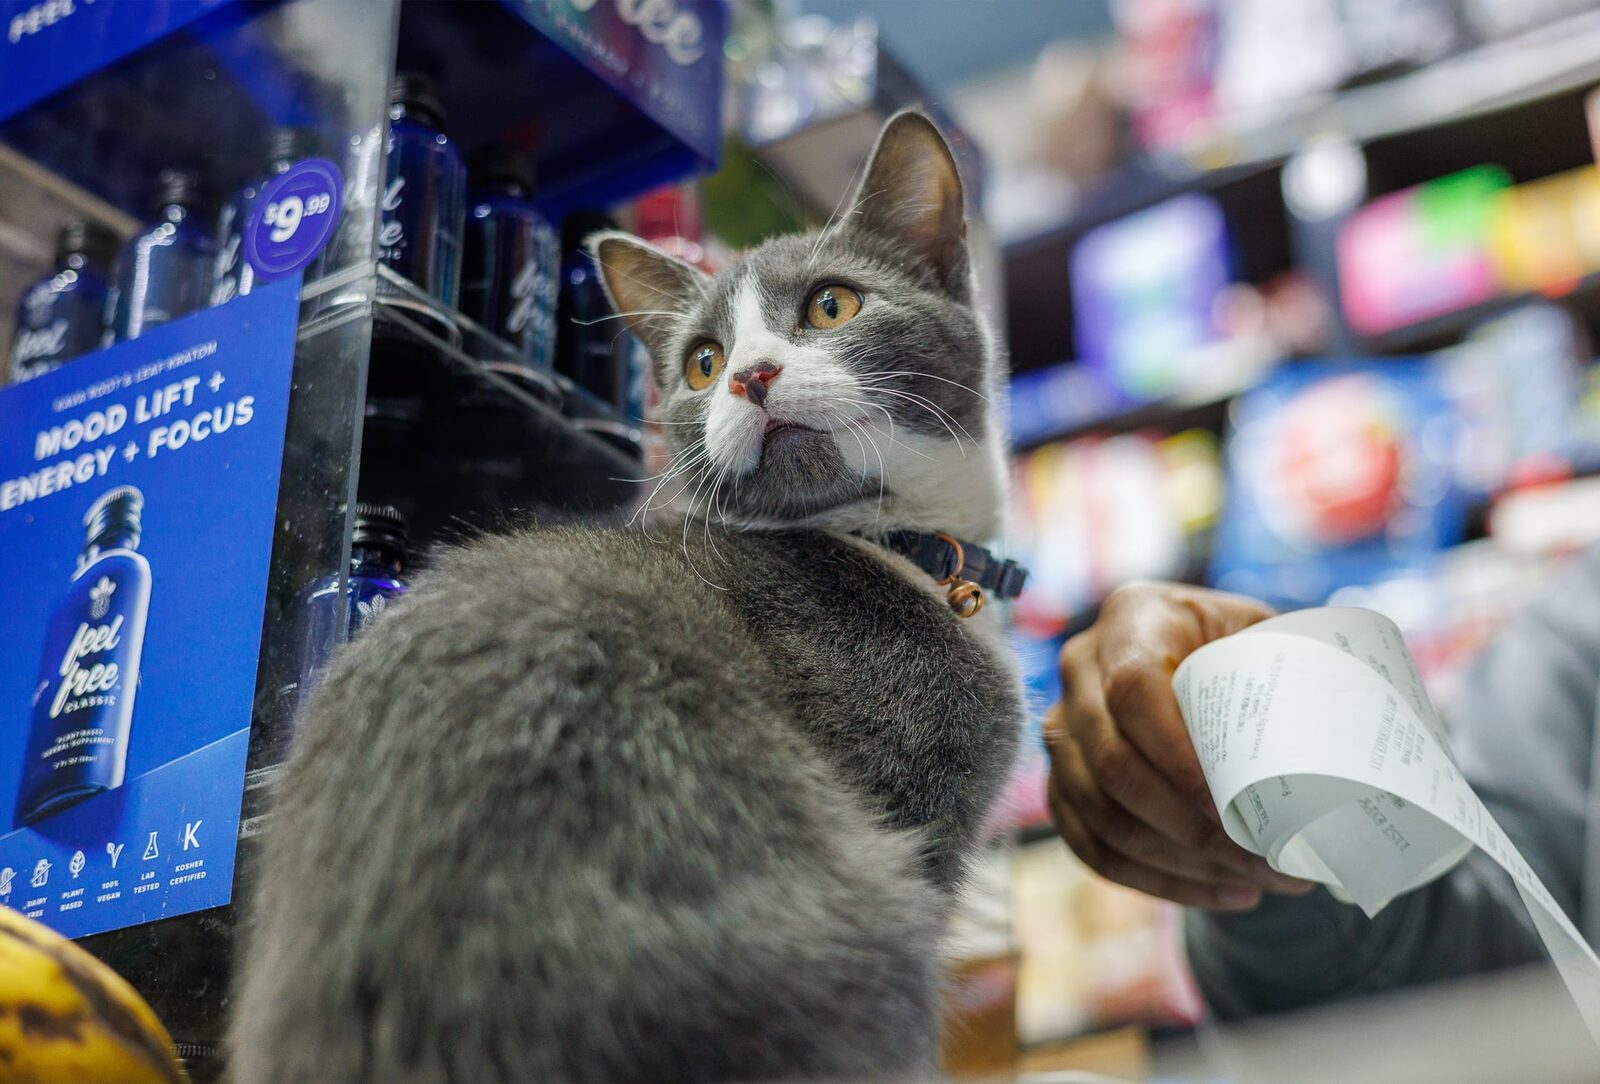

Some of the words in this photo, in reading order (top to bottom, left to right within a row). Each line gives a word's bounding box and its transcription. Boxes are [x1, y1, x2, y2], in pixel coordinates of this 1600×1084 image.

[262, 192, 330, 243] $9.99
[52, 390, 87, 412] KAVA
[86, 376, 122, 400] ROOT
[134, 360, 164, 384] LEAF
[166, 340, 218, 370] KRATOM
[34, 404, 127, 461] MOOD
[134, 375, 201, 424] LIFT
[208, 370, 225, 393] +
[0, 444, 116, 512] ENERGY
[122, 440, 140, 463] +
[147, 395, 255, 458] FOCUS
[59, 614, 124, 677] feel
[49, 661, 119, 719] free
[63, 695, 116, 714] CLASSIC
[69, 737, 115, 748] SUPPLEMENT
[183, 820, 202, 851] K
[175, 860, 204, 873] KOSHER
[141, 871, 156, 881] LAB
[169, 872, 207, 886] CERTIFIED
[101, 880, 120, 891] 100%
[133, 882, 160, 895] TESTED
[62, 888, 85, 899] PLANT
[96, 892, 121, 903] VEGAN
[26, 897, 48, 909] DAIRY
[60, 900, 83, 912] BASED
[27, 909, 44, 919] FREE
